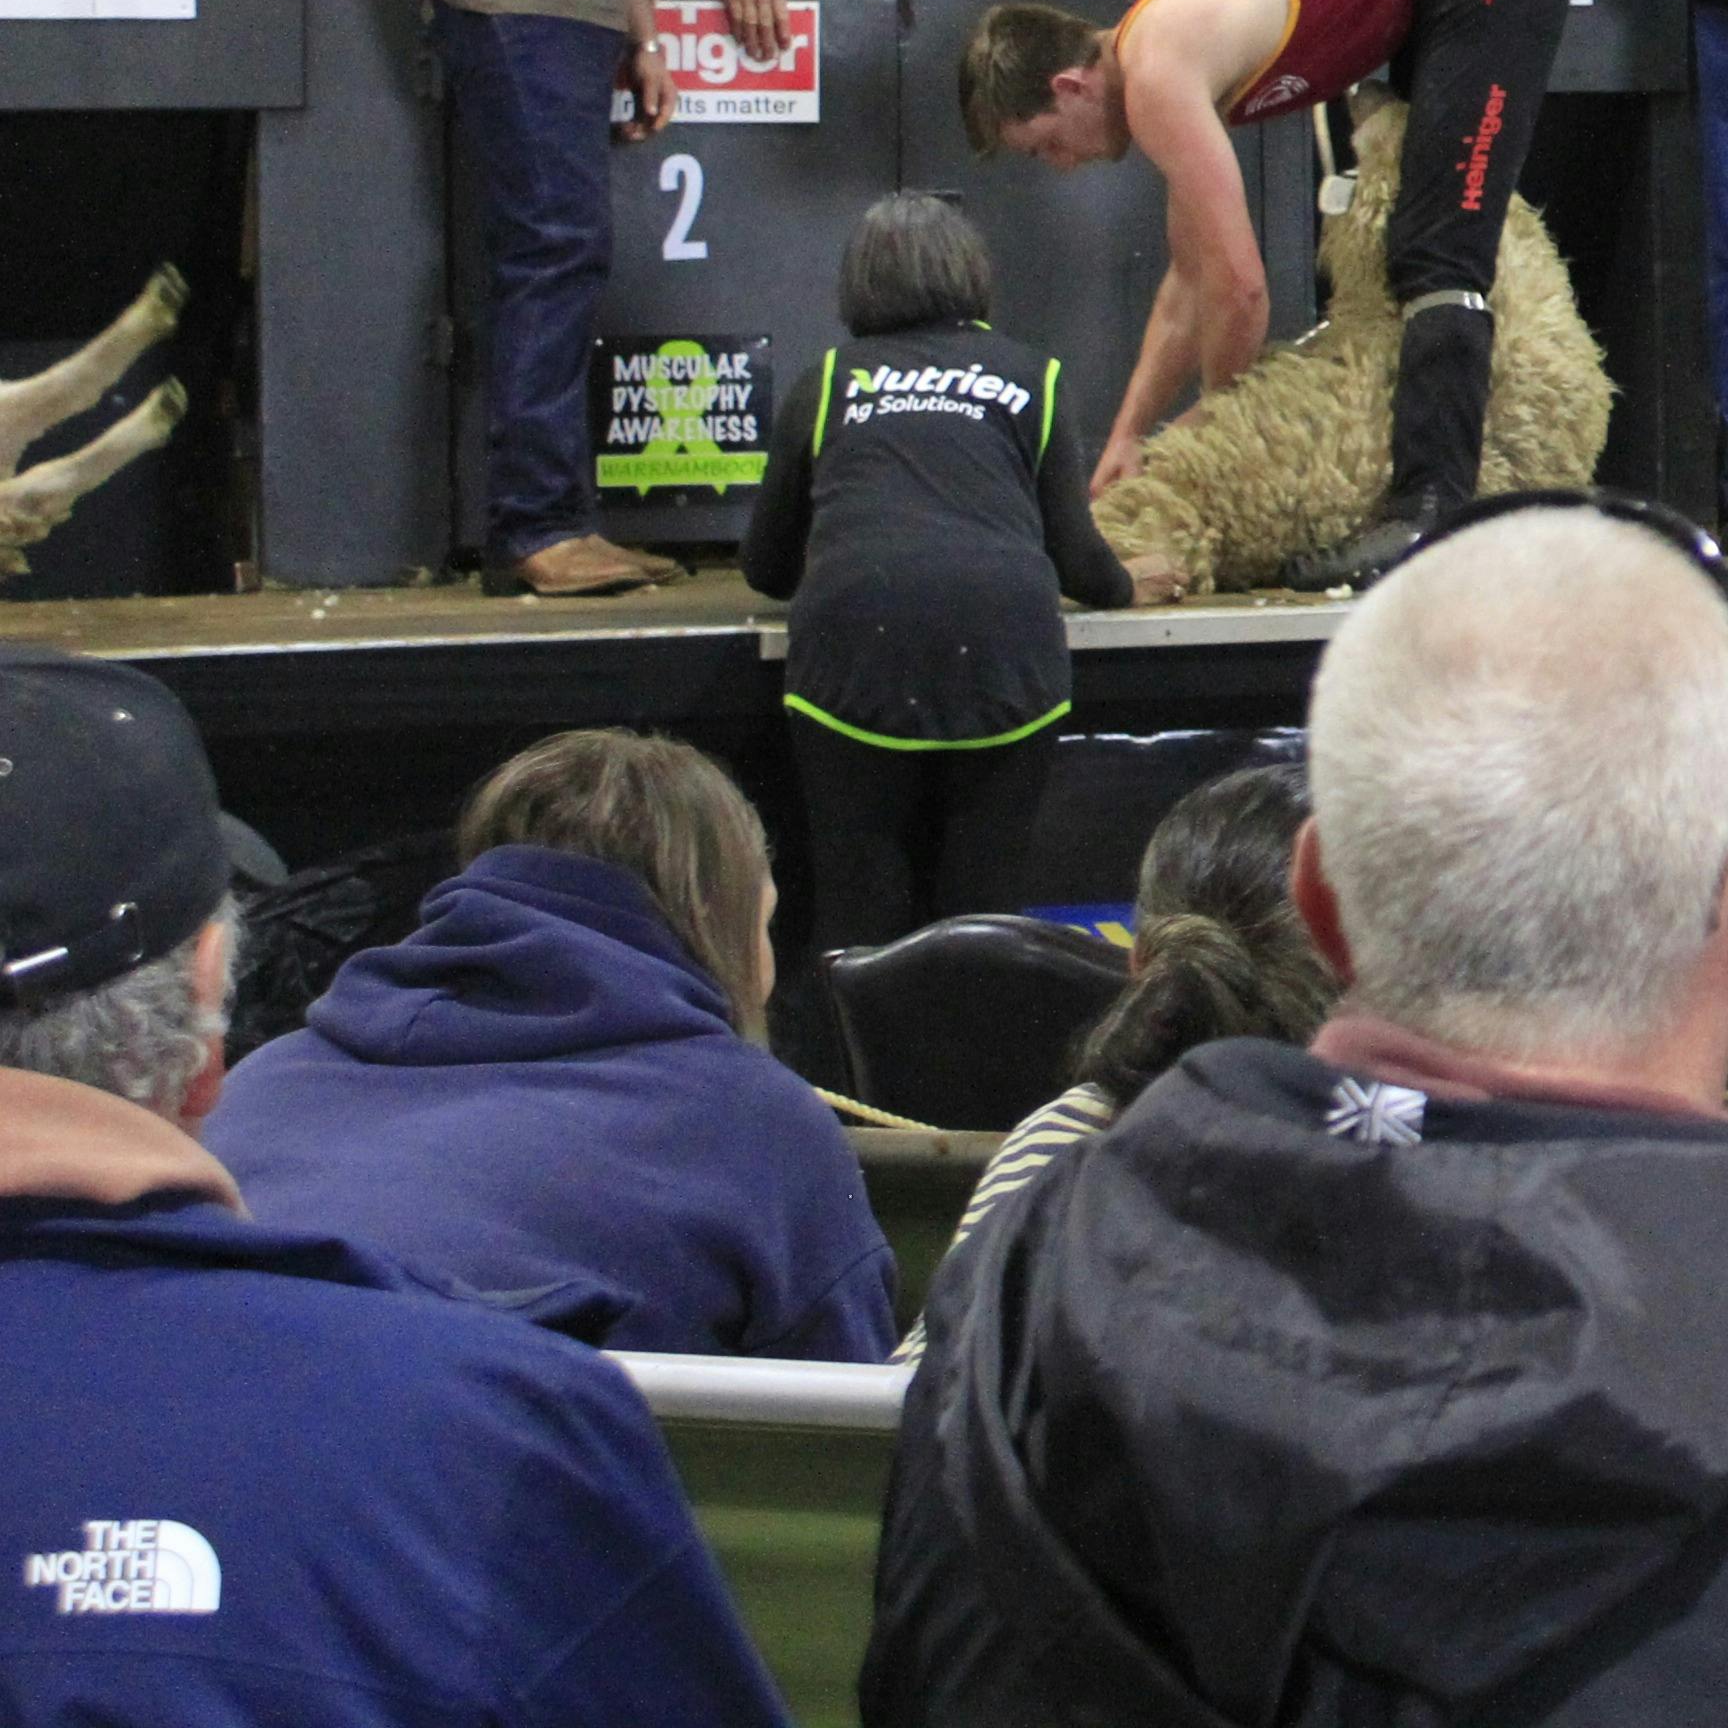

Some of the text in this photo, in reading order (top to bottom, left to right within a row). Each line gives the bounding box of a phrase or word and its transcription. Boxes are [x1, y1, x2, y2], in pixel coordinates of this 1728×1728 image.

[715, 95, 798, 116] matter
[1455, 82, 1508, 211] Heiniger
[658, 153, 709, 261] 2
[613, 352, 752, 382] MUSCULAR
[611, 383, 753, 414] DYSTROPHY
[845, 363, 1032, 415] Nutrien
[843, 394, 987, 425] Ag Solutions
[606, 413, 758, 445] AWARENESS
[85, 1519, 157, 1550] THE
[26, 1550, 155, 1586] NORTH
[60, 1580, 151, 1613] FACE
